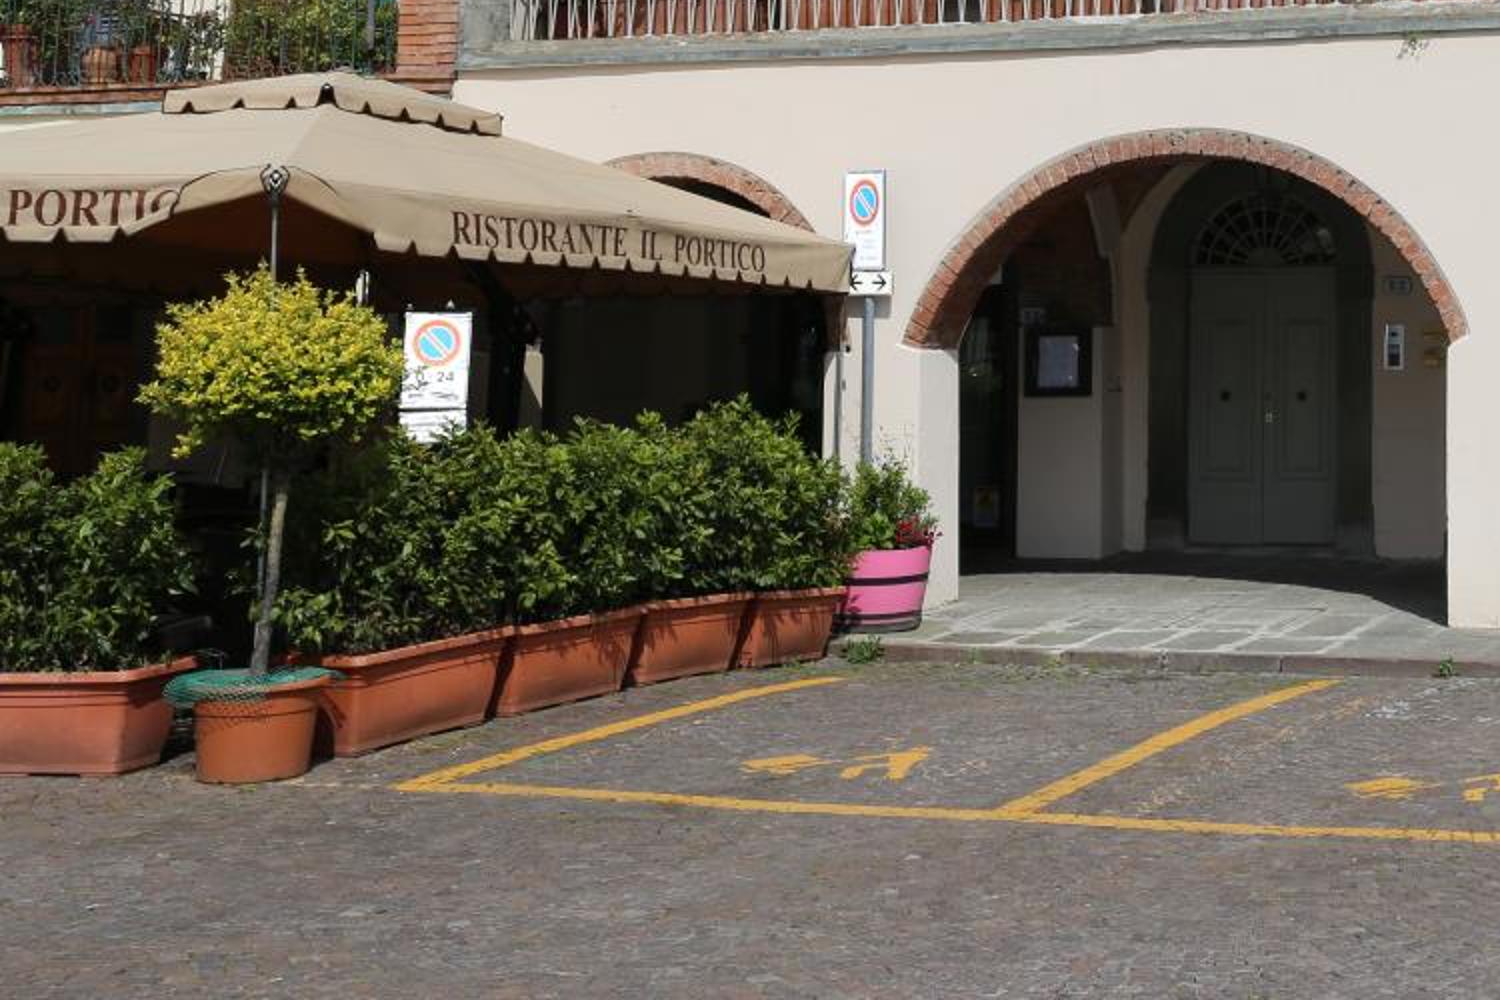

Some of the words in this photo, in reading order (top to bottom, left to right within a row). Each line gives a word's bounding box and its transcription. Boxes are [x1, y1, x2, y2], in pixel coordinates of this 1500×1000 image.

[451, 211, 628, 258] RISTORANTE
[640, 230, 663, 261] IL
[674, 235, 767, 273] PORTICO
